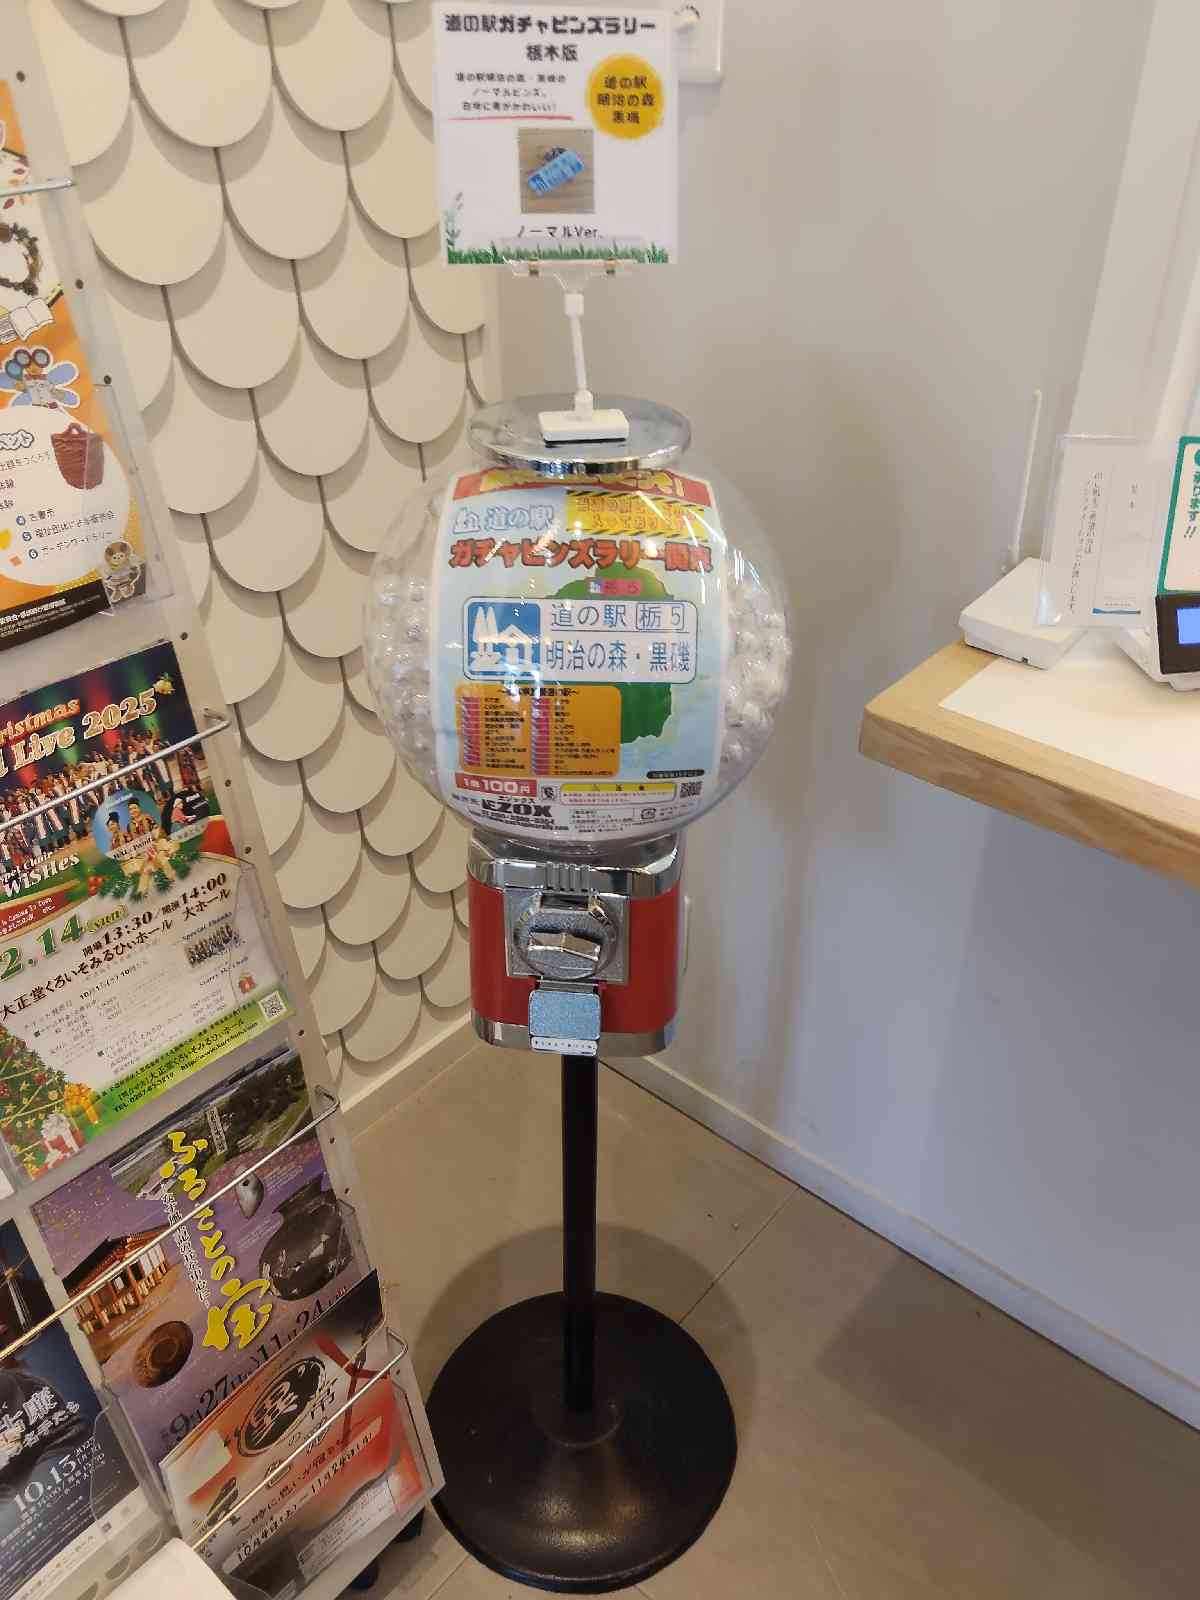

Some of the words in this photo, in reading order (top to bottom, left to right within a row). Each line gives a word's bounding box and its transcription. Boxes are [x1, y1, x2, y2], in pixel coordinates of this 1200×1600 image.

[551, 604, 627, 628] 道の駅
[545, 640, 691, 673] 明治の森・黒磯
[82, 687, 157, 740] 2025
[481, 800, 553, 817] EZOX
[182, 887, 232, 922] 大ホール
